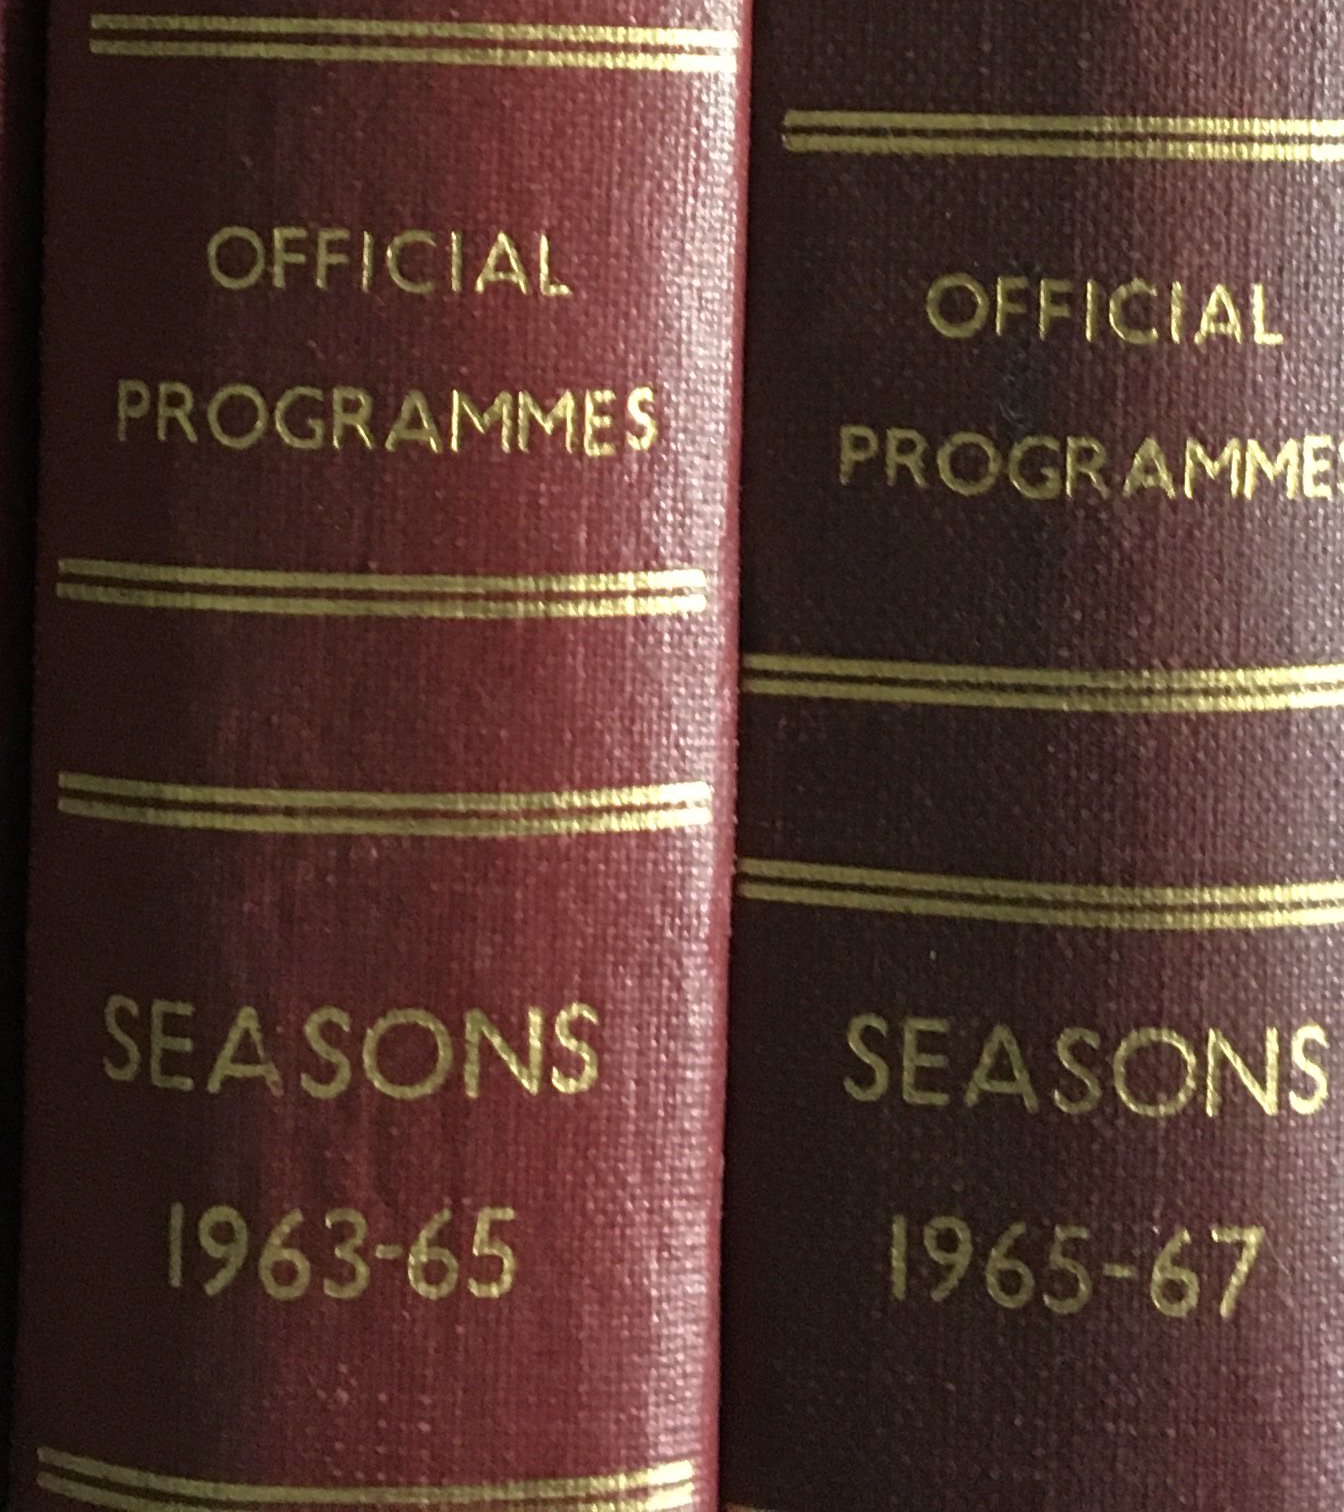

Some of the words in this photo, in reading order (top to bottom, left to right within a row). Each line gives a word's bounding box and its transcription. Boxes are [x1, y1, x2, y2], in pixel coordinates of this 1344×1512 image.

[208, 226, 572, 297] OFFICIAL
[926, 274, 1284, 347] OFFICIAL
[119, 381, 659, 459] PROGRAMMES
[103, 1001, 599, 1100] SEASONS
[843, 1015, 1330, 1118] SEASONS
[170, 1203, 517, 1300] 1963-65
[890, 1215, 1265, 1317] 1965-67
